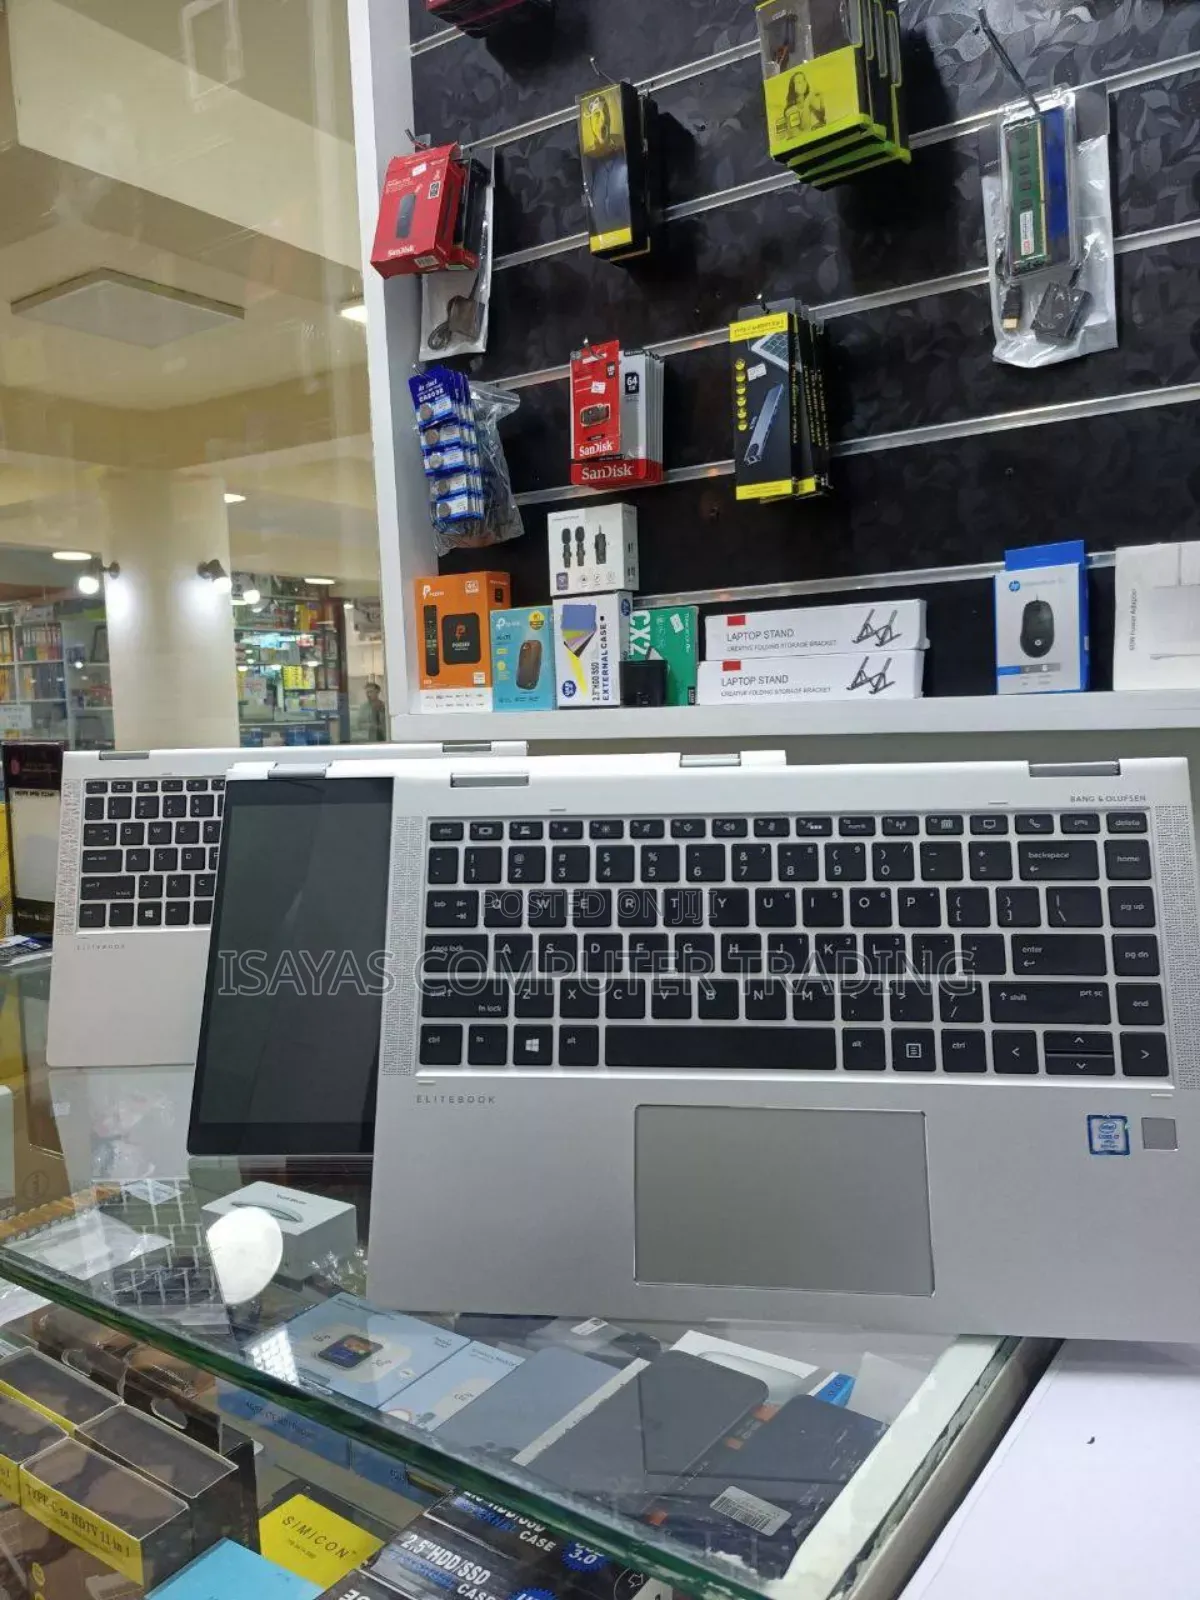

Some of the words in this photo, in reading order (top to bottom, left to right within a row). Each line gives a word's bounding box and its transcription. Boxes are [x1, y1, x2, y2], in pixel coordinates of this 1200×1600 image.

[627, 376, 637, 386] 64
[580, 440, 613, 457] SanDisk
[582, 465, 633, 480] SanDisk
[600, 624, 608, 649] CASE
[727, 630, 762, 642] LAPTOP
[763, 628, 794, 639] STAND
[601, 650, 610, 701] EXTERNAL
[721, 676, 757, 687] LAPTOP
[758, 674, 788, 684] STAND
[803, 686, 831, 694] BRACKET
[1028, 852, 1070, 860] backspace
[470, 869, 475, 878] 1
[514, 869, 522, 878] 2
[558, 868, 566, 878] 3
[603, 868, 611, 877] 4
[648, 868, 656, 877] 5
[694, 866, 702, 876] 6
[740, 866, 748, 876] 7
[786, 866, 794, 876] 8
[834, 866, 842, 876] 9
[881, 866, 890, 875] 0
[492, 899, 502, 910] Q
[537, 899, 550, 909] W
[580, 899, 588, 909] E
[625, 899, 634, 908] R
[671, 898, 680, 908] T
[717, 898, 727, 908] Y
[764, 898, 773, 908] U
[810, 898, 814, 908] I
[858, 897, 870, 908] O
[906, 897, 916, 907] P
[502, 944, 512, 953] A
[546, 944, 554, 953] S
[592, 944, 600, 953] D
[636, 944, 644, 953] F
[683, 944, 692, 953] G
[730, 944, 738, 953] H
[776, 944, 784, 953] J
[824, 944, 834, 954] K
[872, 944, 880, 954] L
[1124, 951, 1136, 959] pg
[522, 990, 531, 999] Z
[568, 990, 576, 1000] X
[613, 990, 622, 1000] C
[660, 990, 670, 1000] V
[706, 990, 715, 1000] B
[753, 990, 763, 1000] N
[802, 990, 812, 1000] M
[487, 1004, 502, 1012] lock
[952, 1042, 966, 1050] ctrl
[416, 1096, 496, 1104] ELITEBOOK
[71, 1512, 99, 1536] HDTV
[519, 1530, 556, 1552] CASE
[568, 1550, 598, 1565] 3.0
